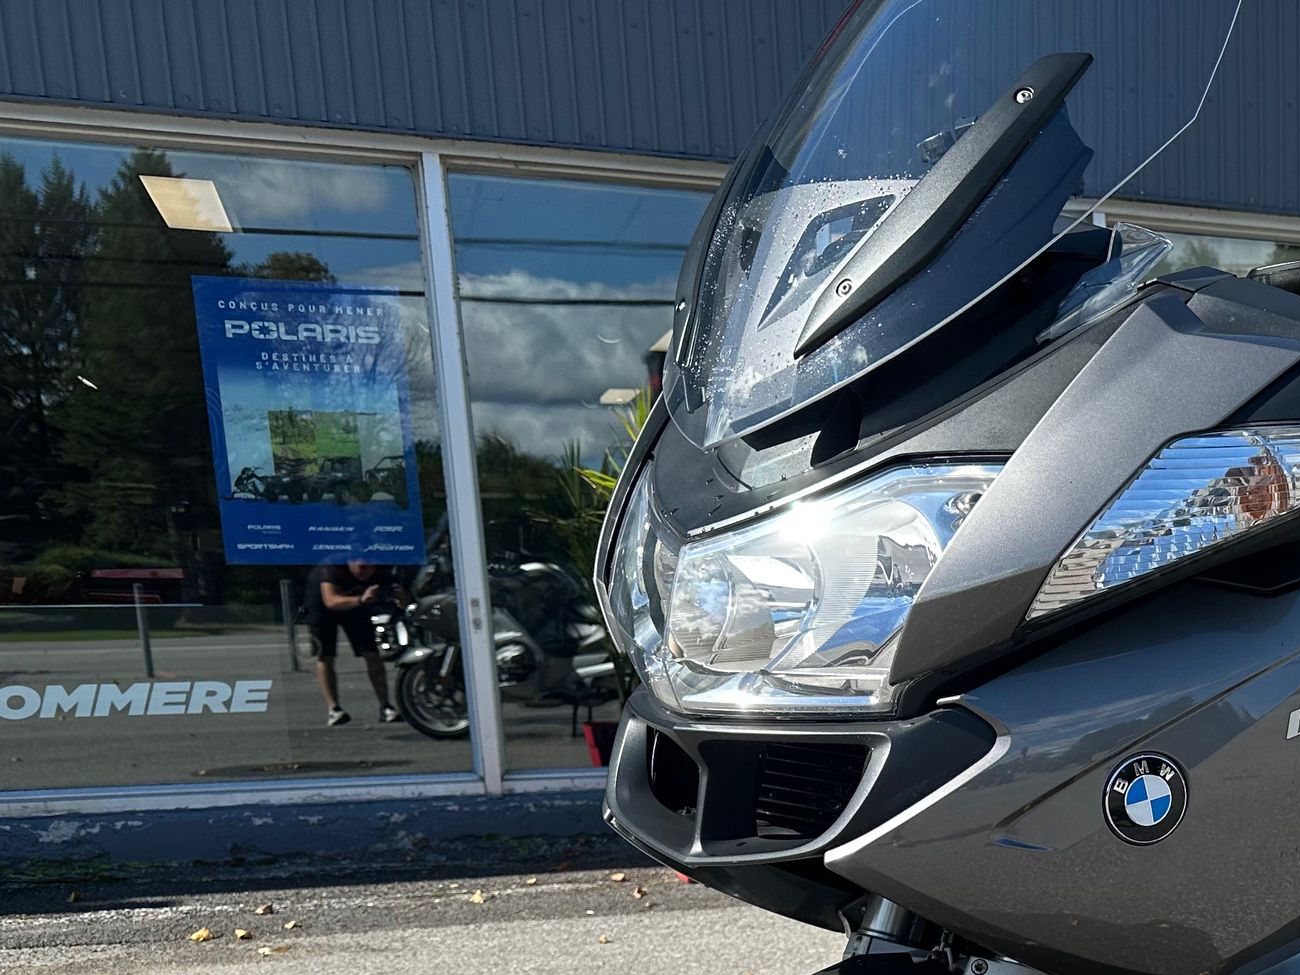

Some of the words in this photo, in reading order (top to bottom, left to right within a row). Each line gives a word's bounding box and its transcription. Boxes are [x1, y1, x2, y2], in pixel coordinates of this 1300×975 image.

[218, 300, 279, 312] CONÇUS
[288, 303, 327, 314] POUR
[335, 306, 384, 316] MENER
[224, 319, 382, 345] POLARIS
[255, 362, 361, 374] S'AVENTURER
[1113, 760, 1176, 794] BMW
